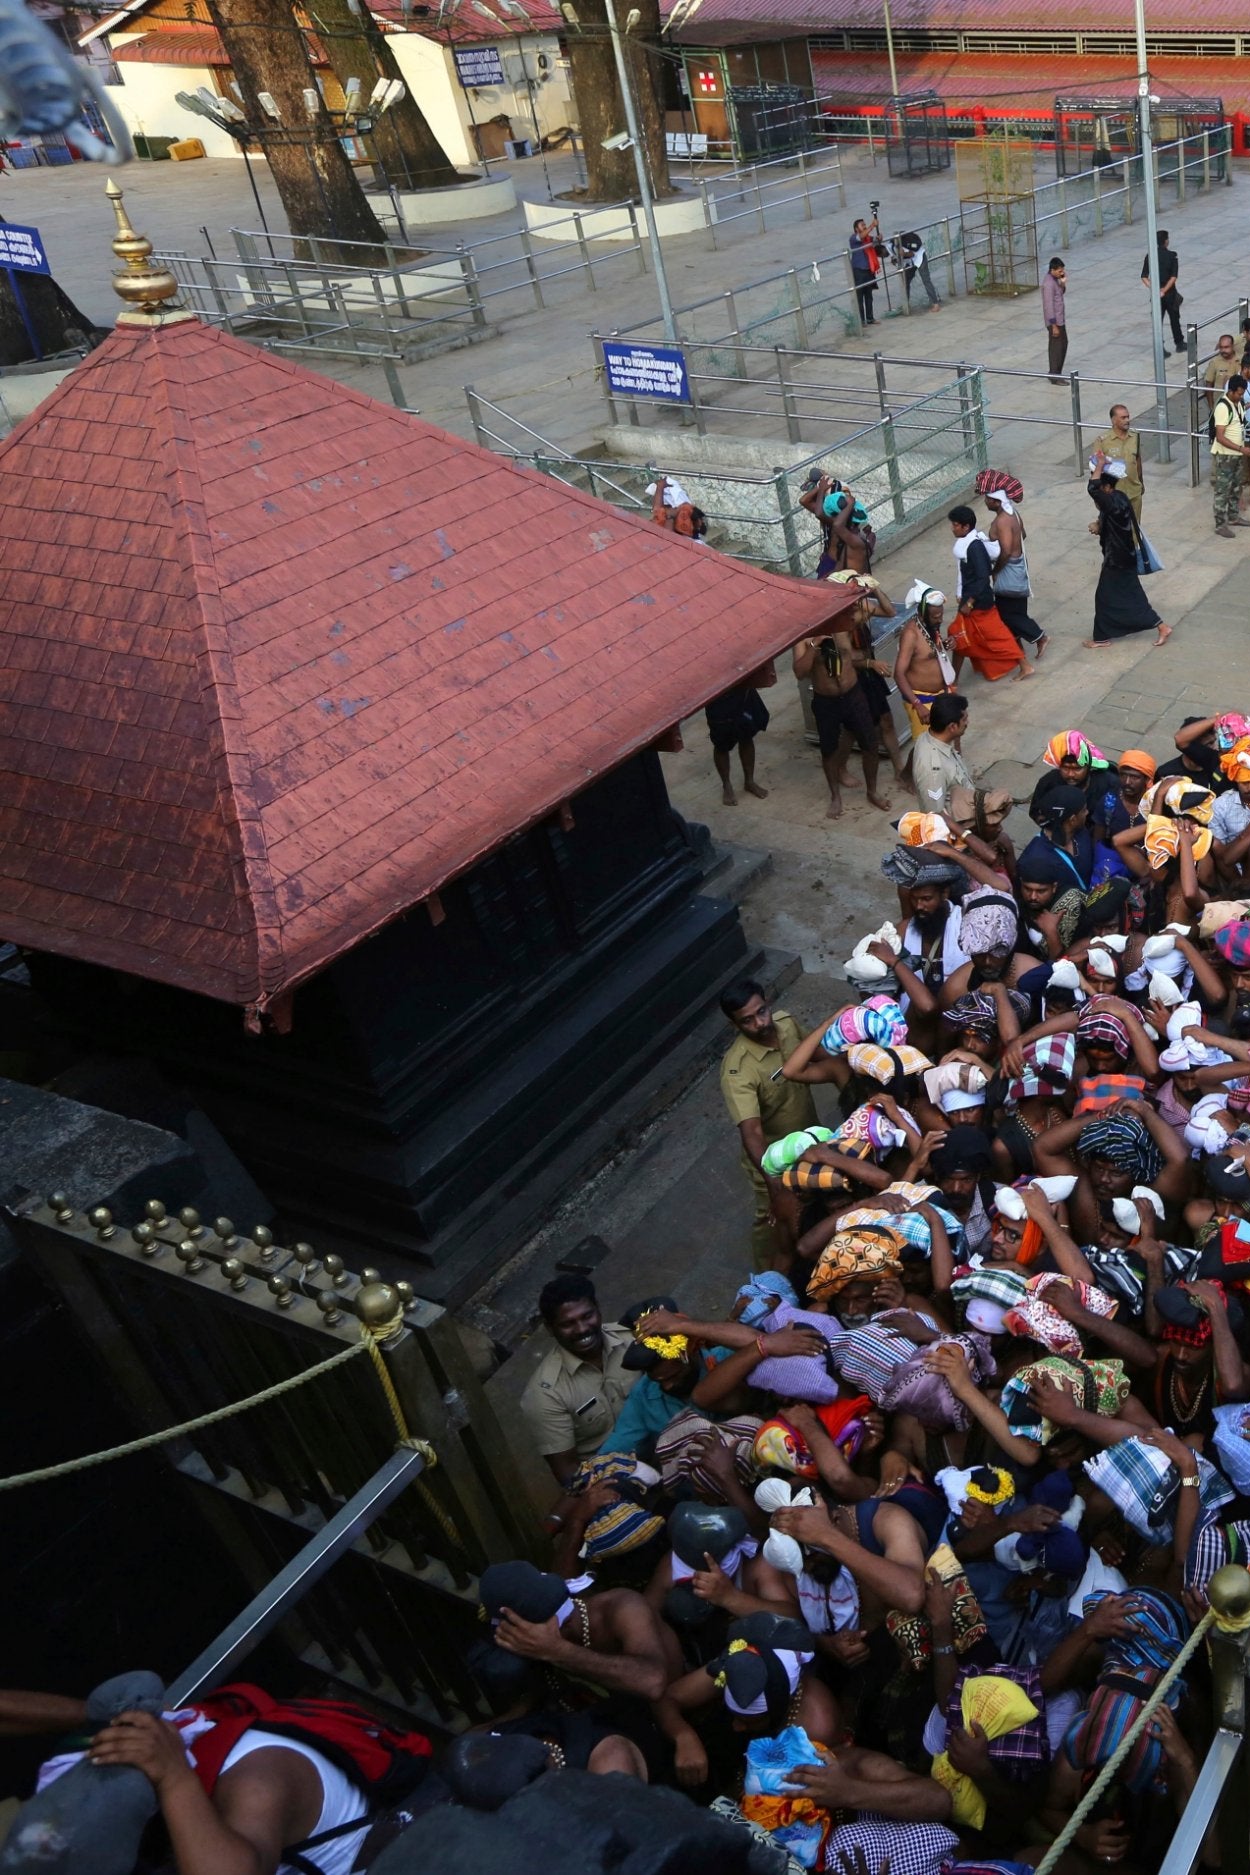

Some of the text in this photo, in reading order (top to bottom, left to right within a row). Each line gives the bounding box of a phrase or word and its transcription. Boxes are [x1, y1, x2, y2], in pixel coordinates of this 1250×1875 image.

[608, 354, 623, 365] WAY
[623, 356, 632, 366] TO
[632, 358, 676, 371] HOMAKUNDAM
